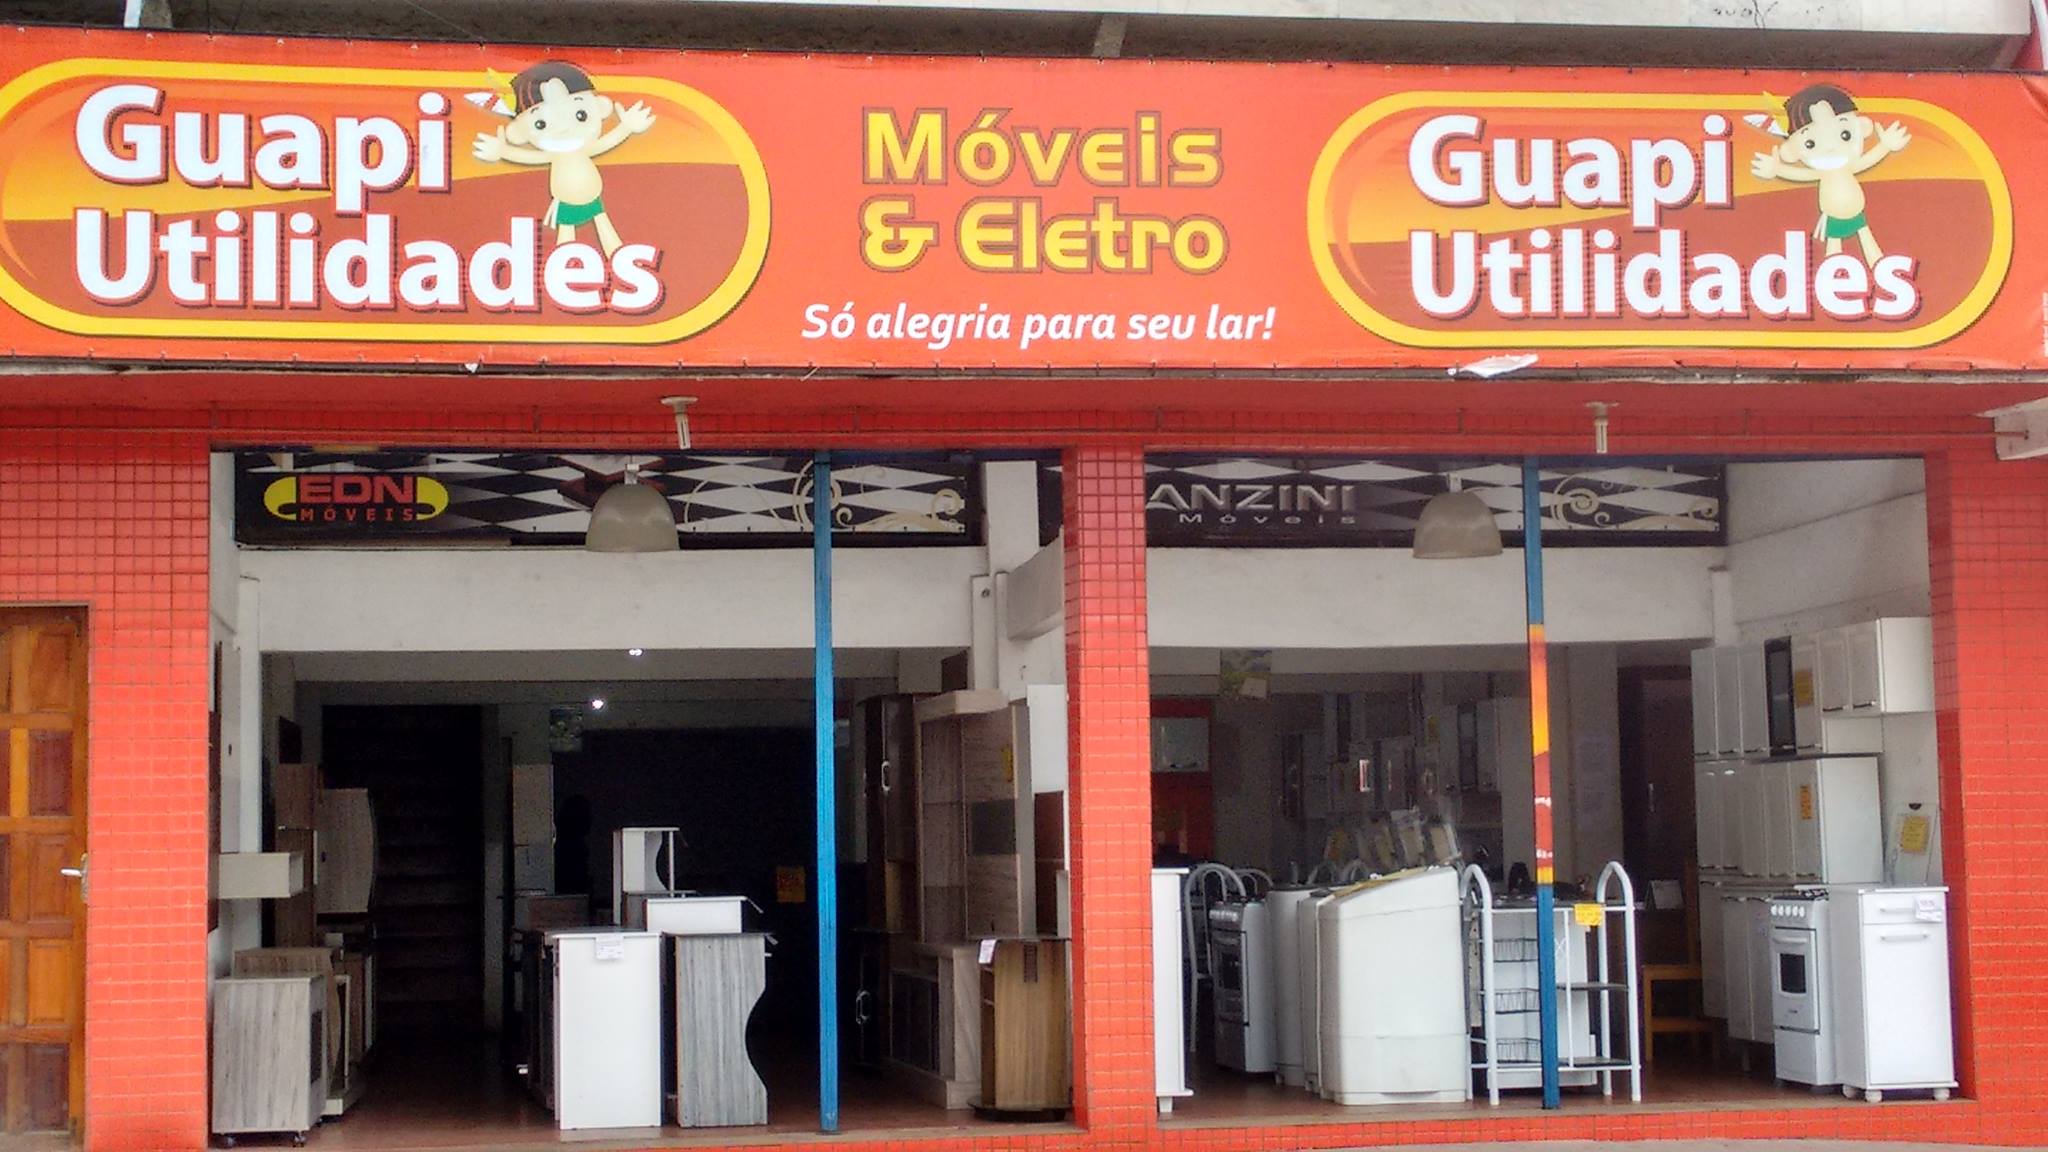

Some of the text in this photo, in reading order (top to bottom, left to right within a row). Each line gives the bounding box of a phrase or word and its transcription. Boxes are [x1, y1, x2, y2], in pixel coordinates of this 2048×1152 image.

[75, 83, 451, 214] Guapi
[862, 107, 1224, 188] Móveis
[1408, 113, 1734, 229] Guapi
[75, 206, 663, 312] Utilidades
[859, 194, 1230, 274] & Eletro
[1408, 227, 1921, 320] Utilidades
[801, 302, 1276, 350] Só alegria para seu lar!
[1145, 484, 1355, 511] ANZINI
